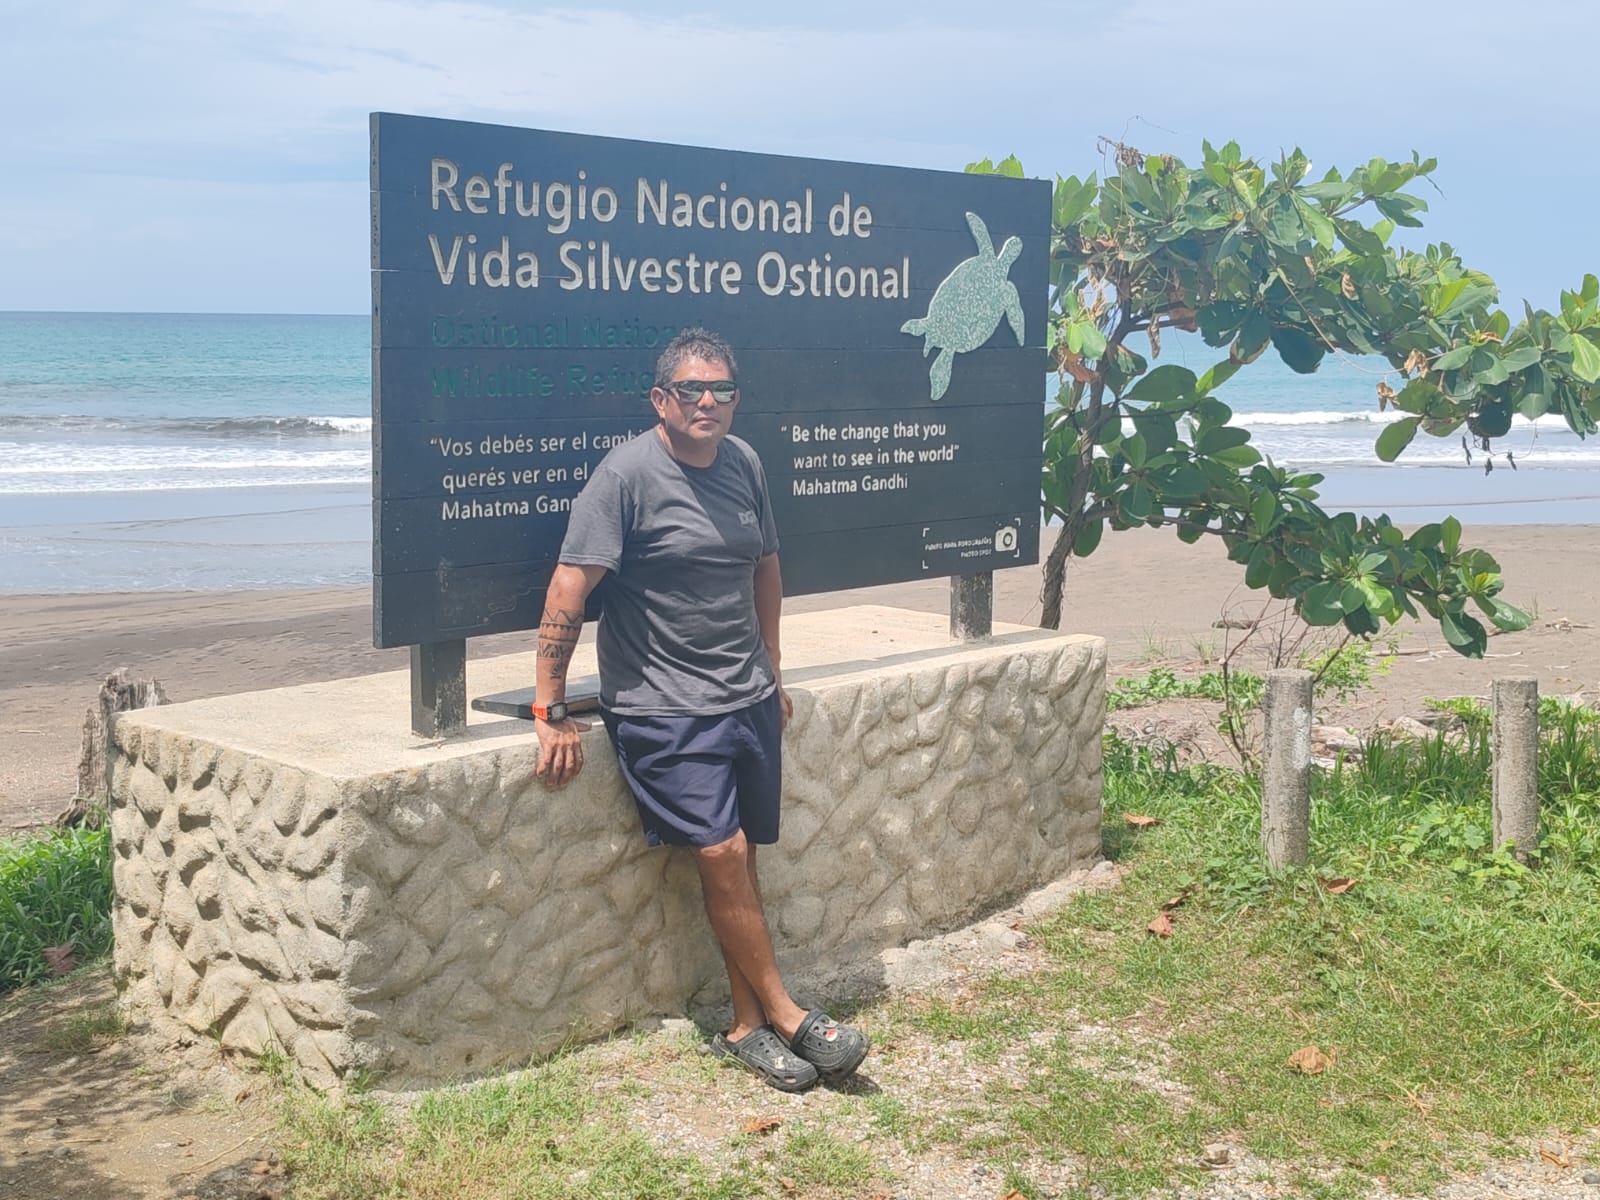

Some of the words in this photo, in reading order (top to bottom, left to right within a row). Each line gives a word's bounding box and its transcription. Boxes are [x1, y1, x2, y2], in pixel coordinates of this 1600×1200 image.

[431, 158, 617, 233] Refugio
[638, 177, 812, 233] Nacional
[829, 192, 873, 237] de
[429, 235, 538, 288] Vida
[560, 241, 741, 294] Silvestre
[758, 252, 909, 298] Ostional
[431, 315, 568, 348] Ostional
[583, 315, 682, 348] Nation
[429, 366, 554, 399] Wildlife
[566, 363, 657, 402] Refug
[431, 439, 472, 456] “Vos
[480, 434, 533, 454] debés
[541, 438, 566, 452] ser
[572, 432, 586, 450] el
[592, 428, 642, 449] camb
[814, 424, 836, 440] the
[841, 424, 889, 443] change
[894, 421, 919, 438] that
[923, 424, 946, 440] you
[794, 454, 827, 469] want
[833, 453, 846, 467] to
[851, 453, 873, 466] see
[878, 448, 889, 464] in
[894, 448, 914, 463] the
[443, 467, 505, 494] querés
[513, 470, 540, 484] ver
[547, 469, 566, 482] en
[574, 462, 587, 480] el
[793, 478, 857, 496] Mahatma
[862, 473, 907, 491] Gandhi
[442, 499, 528, 520] Mahatma
